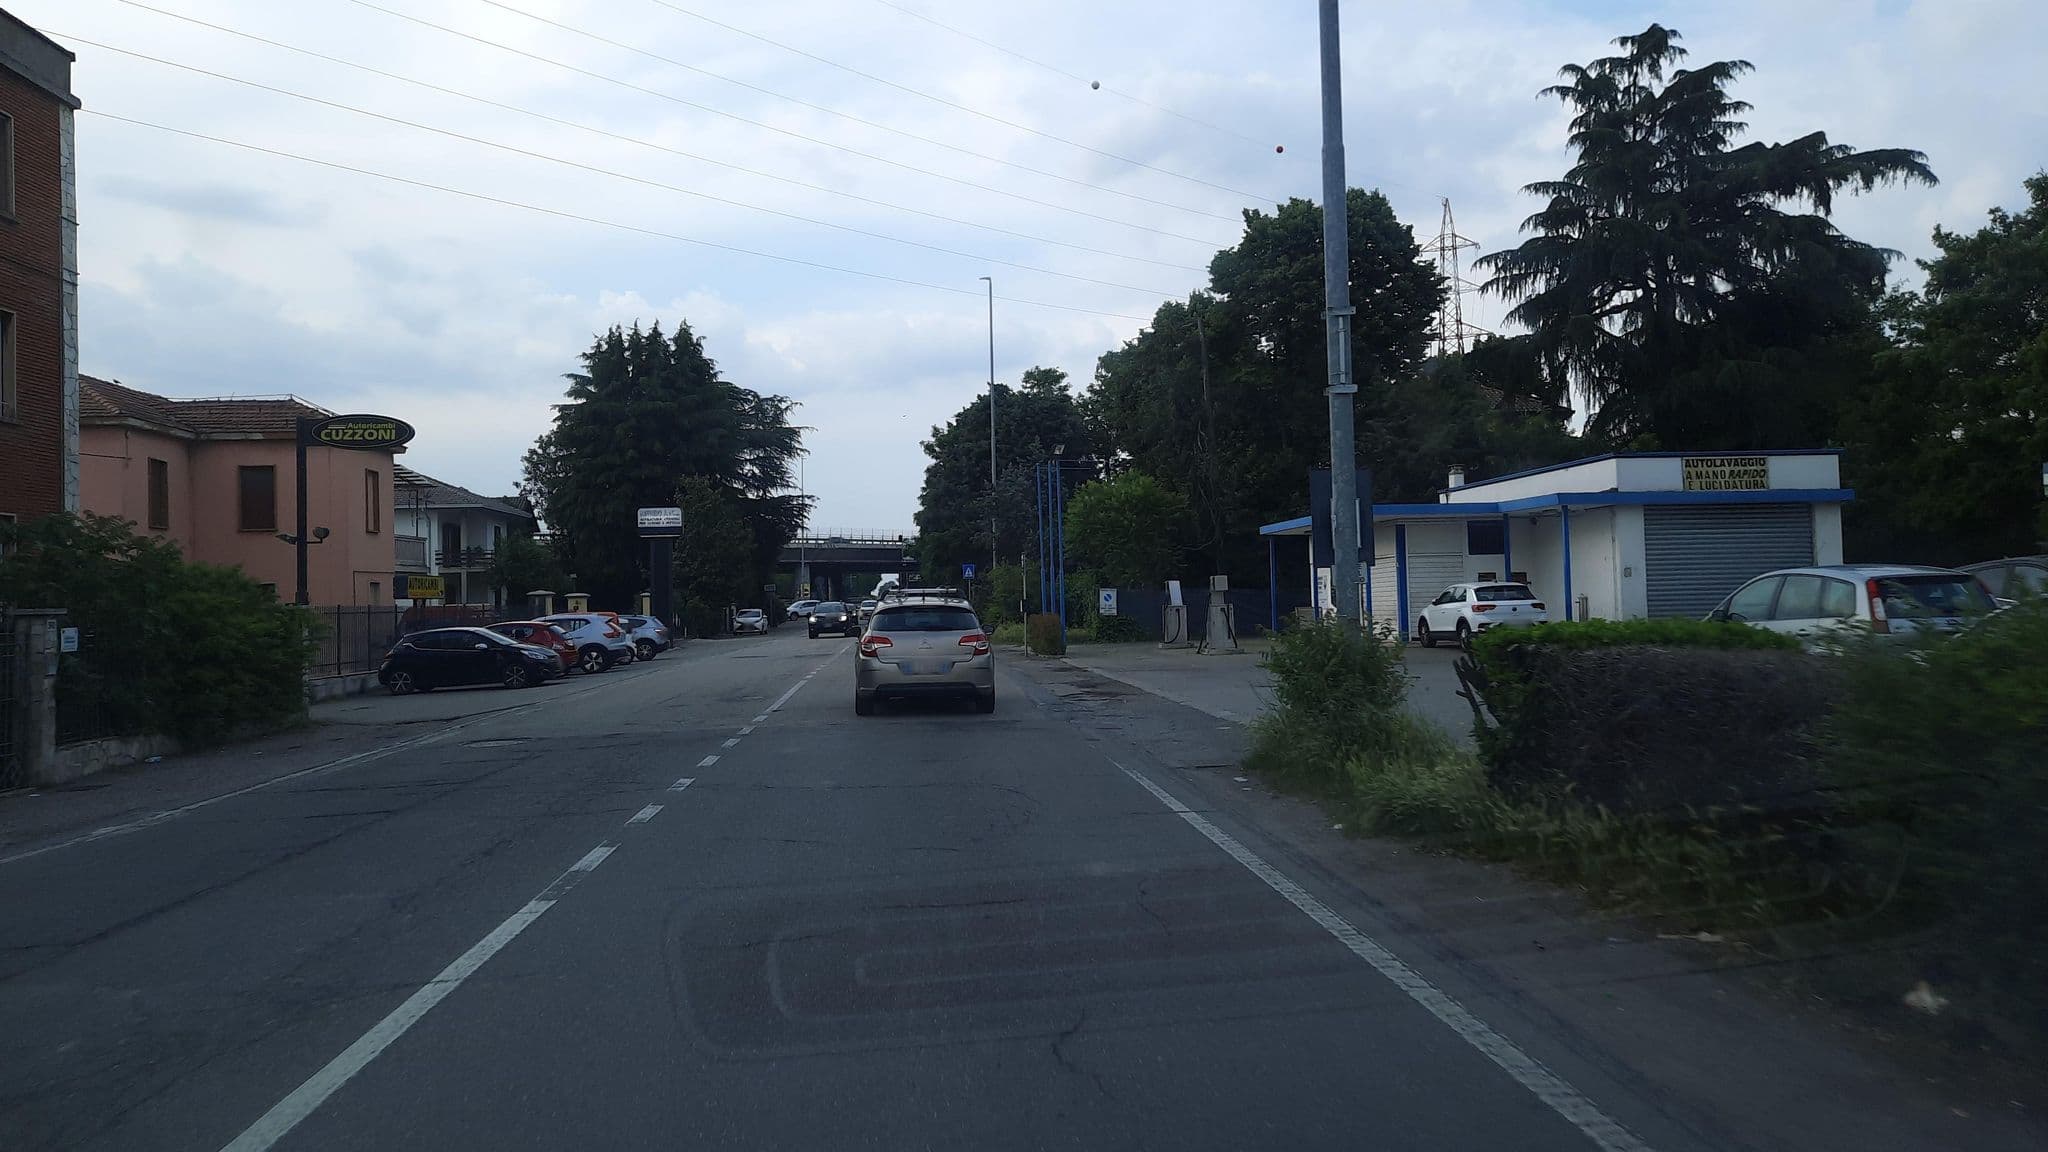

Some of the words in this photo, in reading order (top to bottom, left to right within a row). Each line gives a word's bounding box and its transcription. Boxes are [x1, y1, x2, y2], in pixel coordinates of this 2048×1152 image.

[320, 429, 396, 440] CUZZONI
[1685, 457, 1766, 468] AUTOLAVAGGIO
[1686, 470, 1692, 480] A
[1696, 469, 1726, 480] MANO
[1728, 469, 1766, 479] RAPIDO
[1688, 480, 1693, 490] E
[1699, 479, 1766, 490] LUCIDATURA
